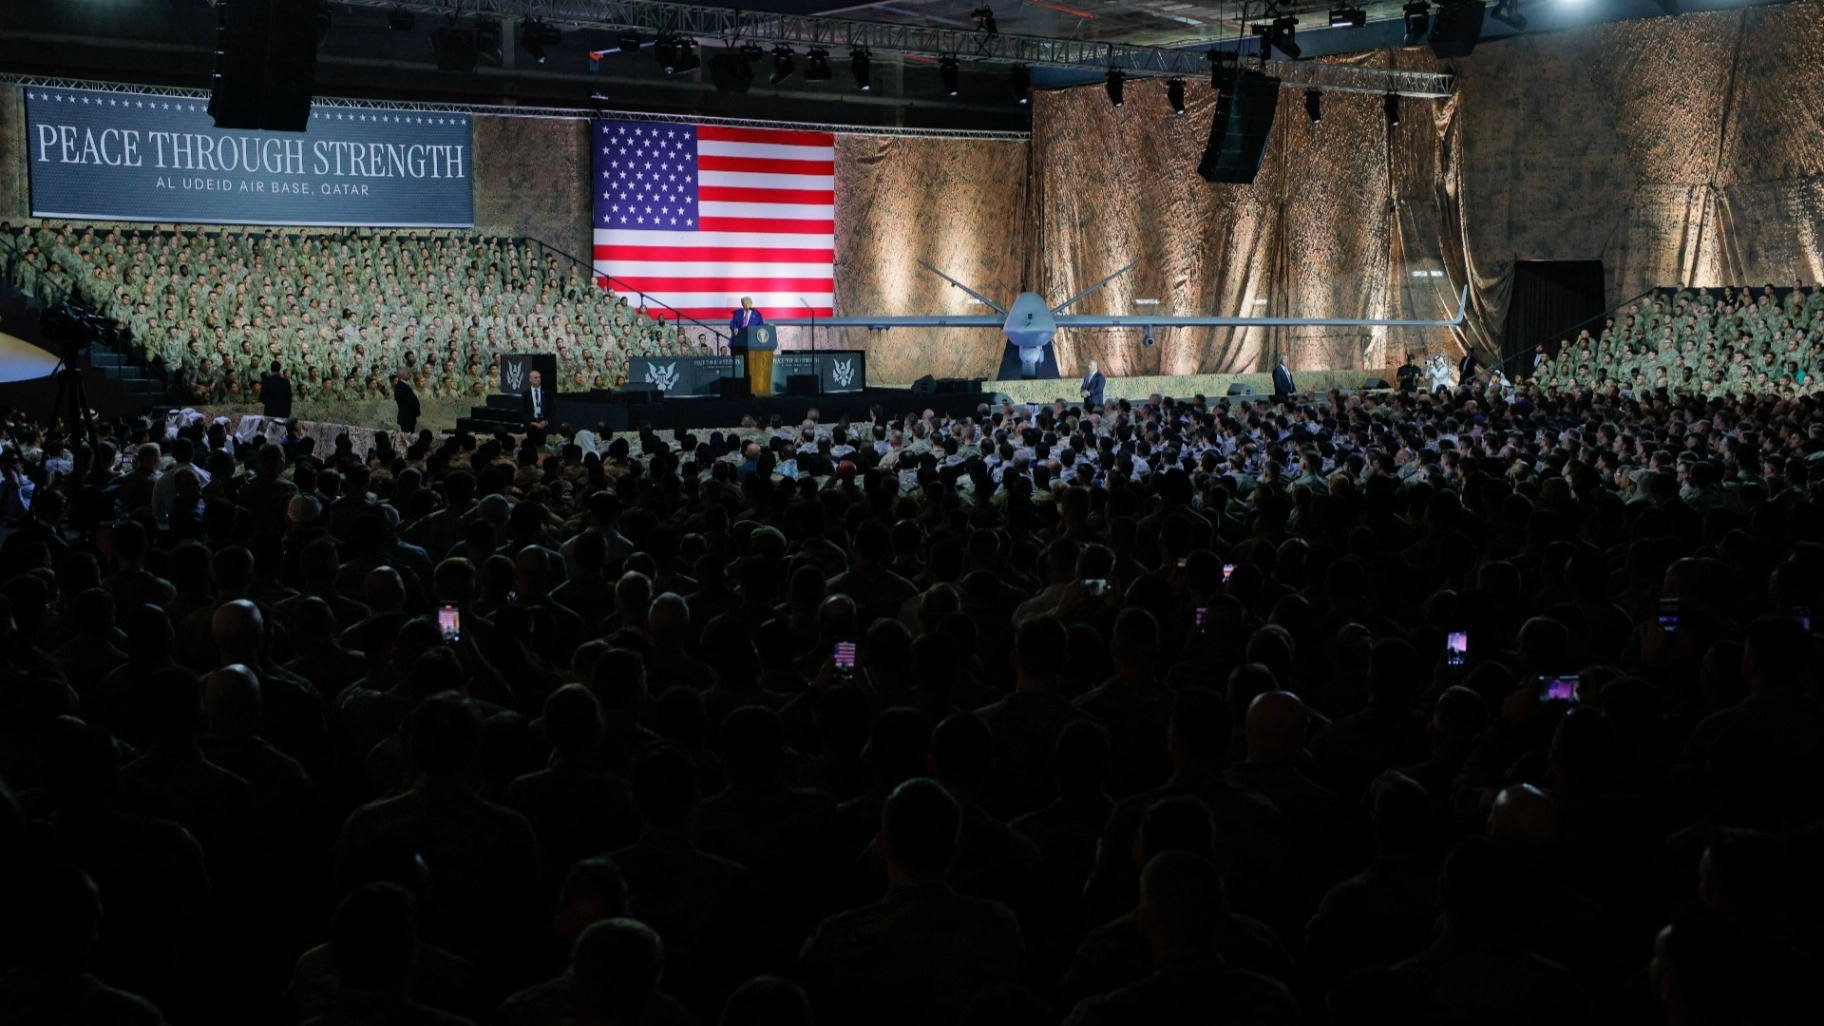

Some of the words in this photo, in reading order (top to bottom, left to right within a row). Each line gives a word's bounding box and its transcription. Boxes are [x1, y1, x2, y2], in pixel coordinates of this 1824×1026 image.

[36, 124, 142, 166] PEACE
[149, 131, 305, 174] THROUGH
[313, 141, 465, 178] STRENGTH
[156, 178, 176, 189] AL
[183, 179, 232, 191] UDEID
[239, 181, 265, 193] AIR
[272, 182, 314, 196] BASE,
[321, 183, 369, 196] QATAR
